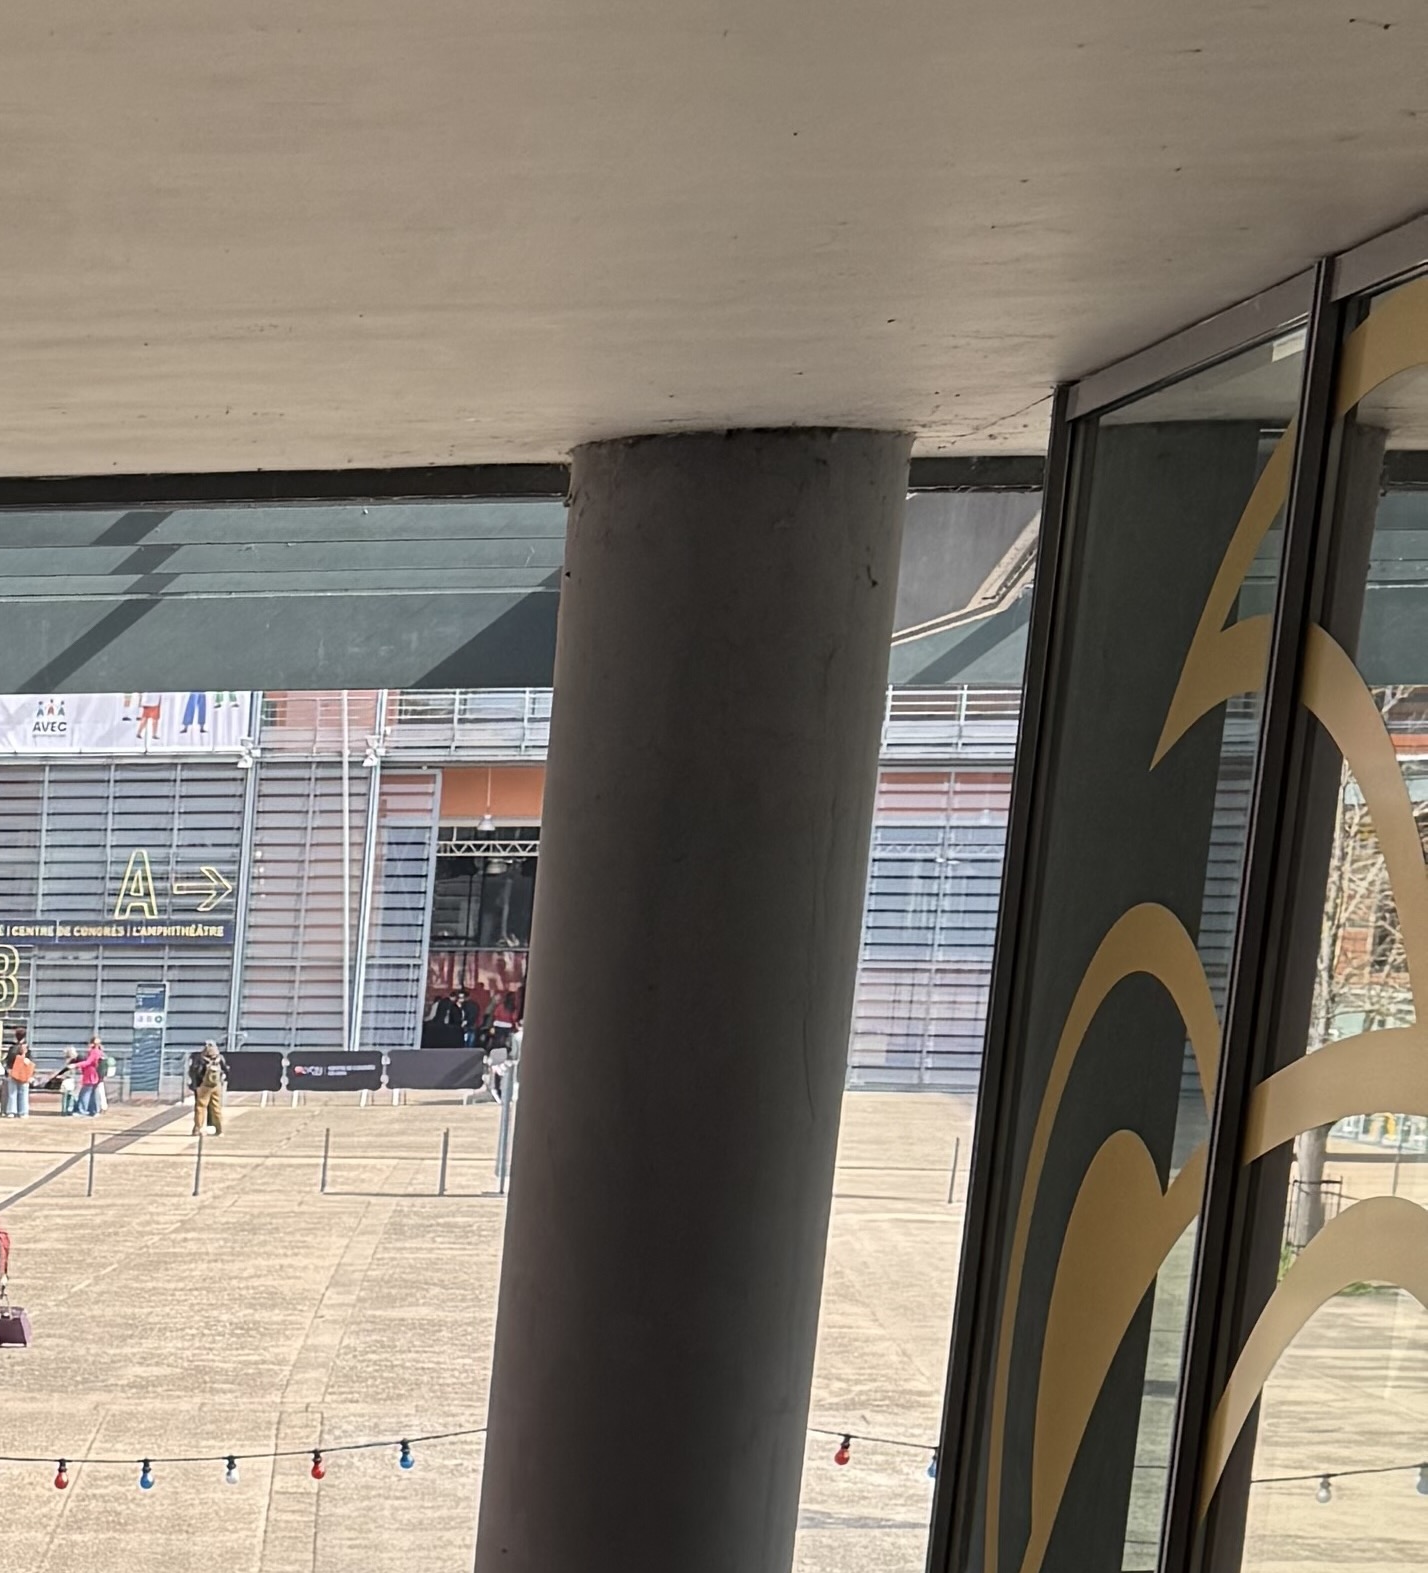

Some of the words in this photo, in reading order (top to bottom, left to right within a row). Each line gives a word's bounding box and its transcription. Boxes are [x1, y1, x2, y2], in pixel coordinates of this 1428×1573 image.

[32, 721, 67, 732] AVEC
[114, 849, 158, 920] A
[11, 924, 54, 937] CENTRE
[57, 925, 71, 937] DE
[73, 923, 125, 938] CONGRÈS
[132, 923, 225, 938] L'AMPHITHÉÂTRE
